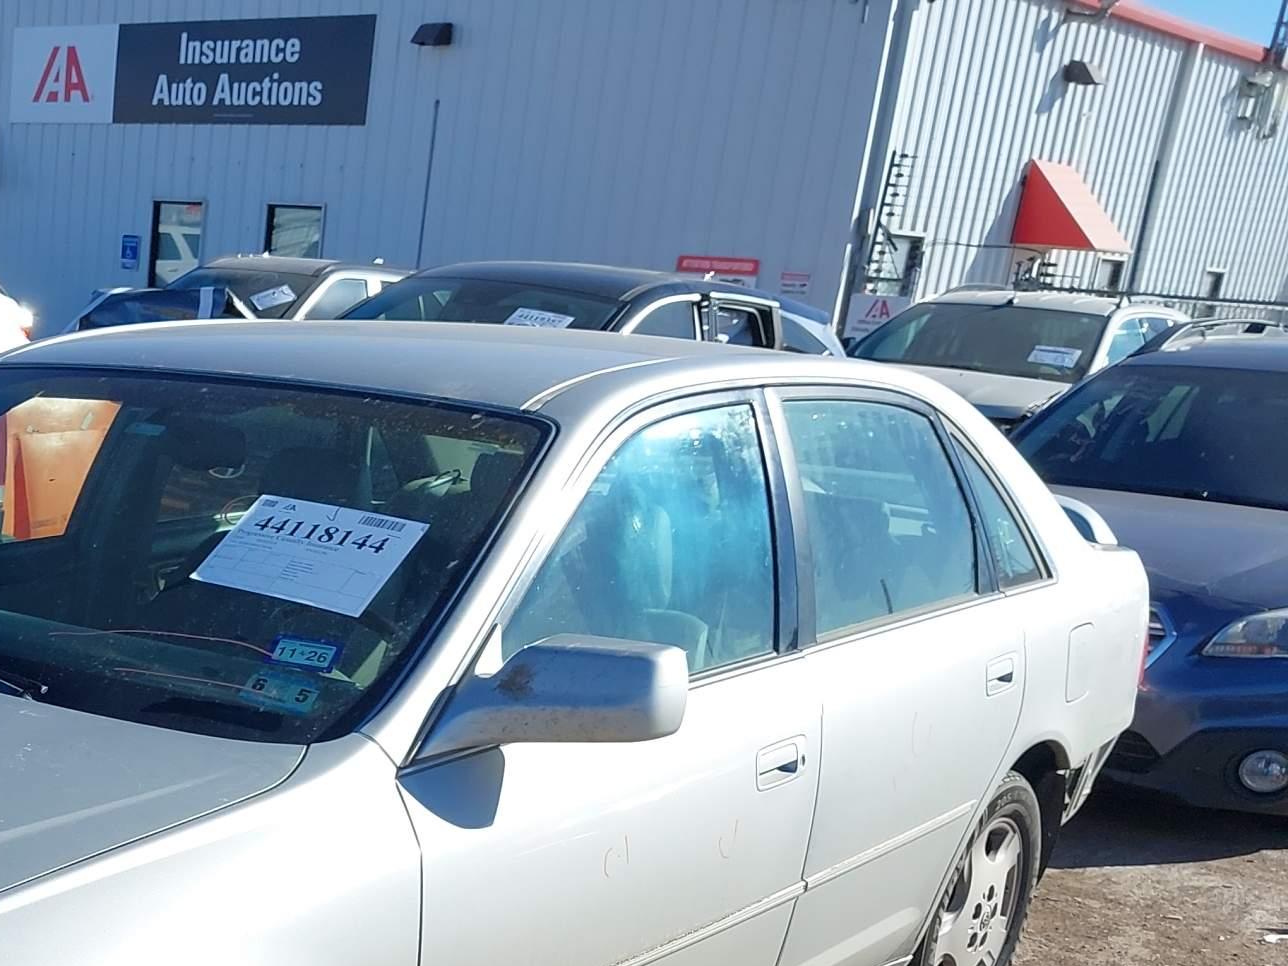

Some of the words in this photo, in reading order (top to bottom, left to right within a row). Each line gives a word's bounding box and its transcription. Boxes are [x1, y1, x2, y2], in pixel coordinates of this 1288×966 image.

[179, 31, 300, 65] Insurance
[152, 73, 208, 107] Auto
[212, 72, 323, 107] Auctions
[254, 515, 390, 554] 44118144
[252, 677, 269, 692] 6
[294, 687, 313, 704] 5
